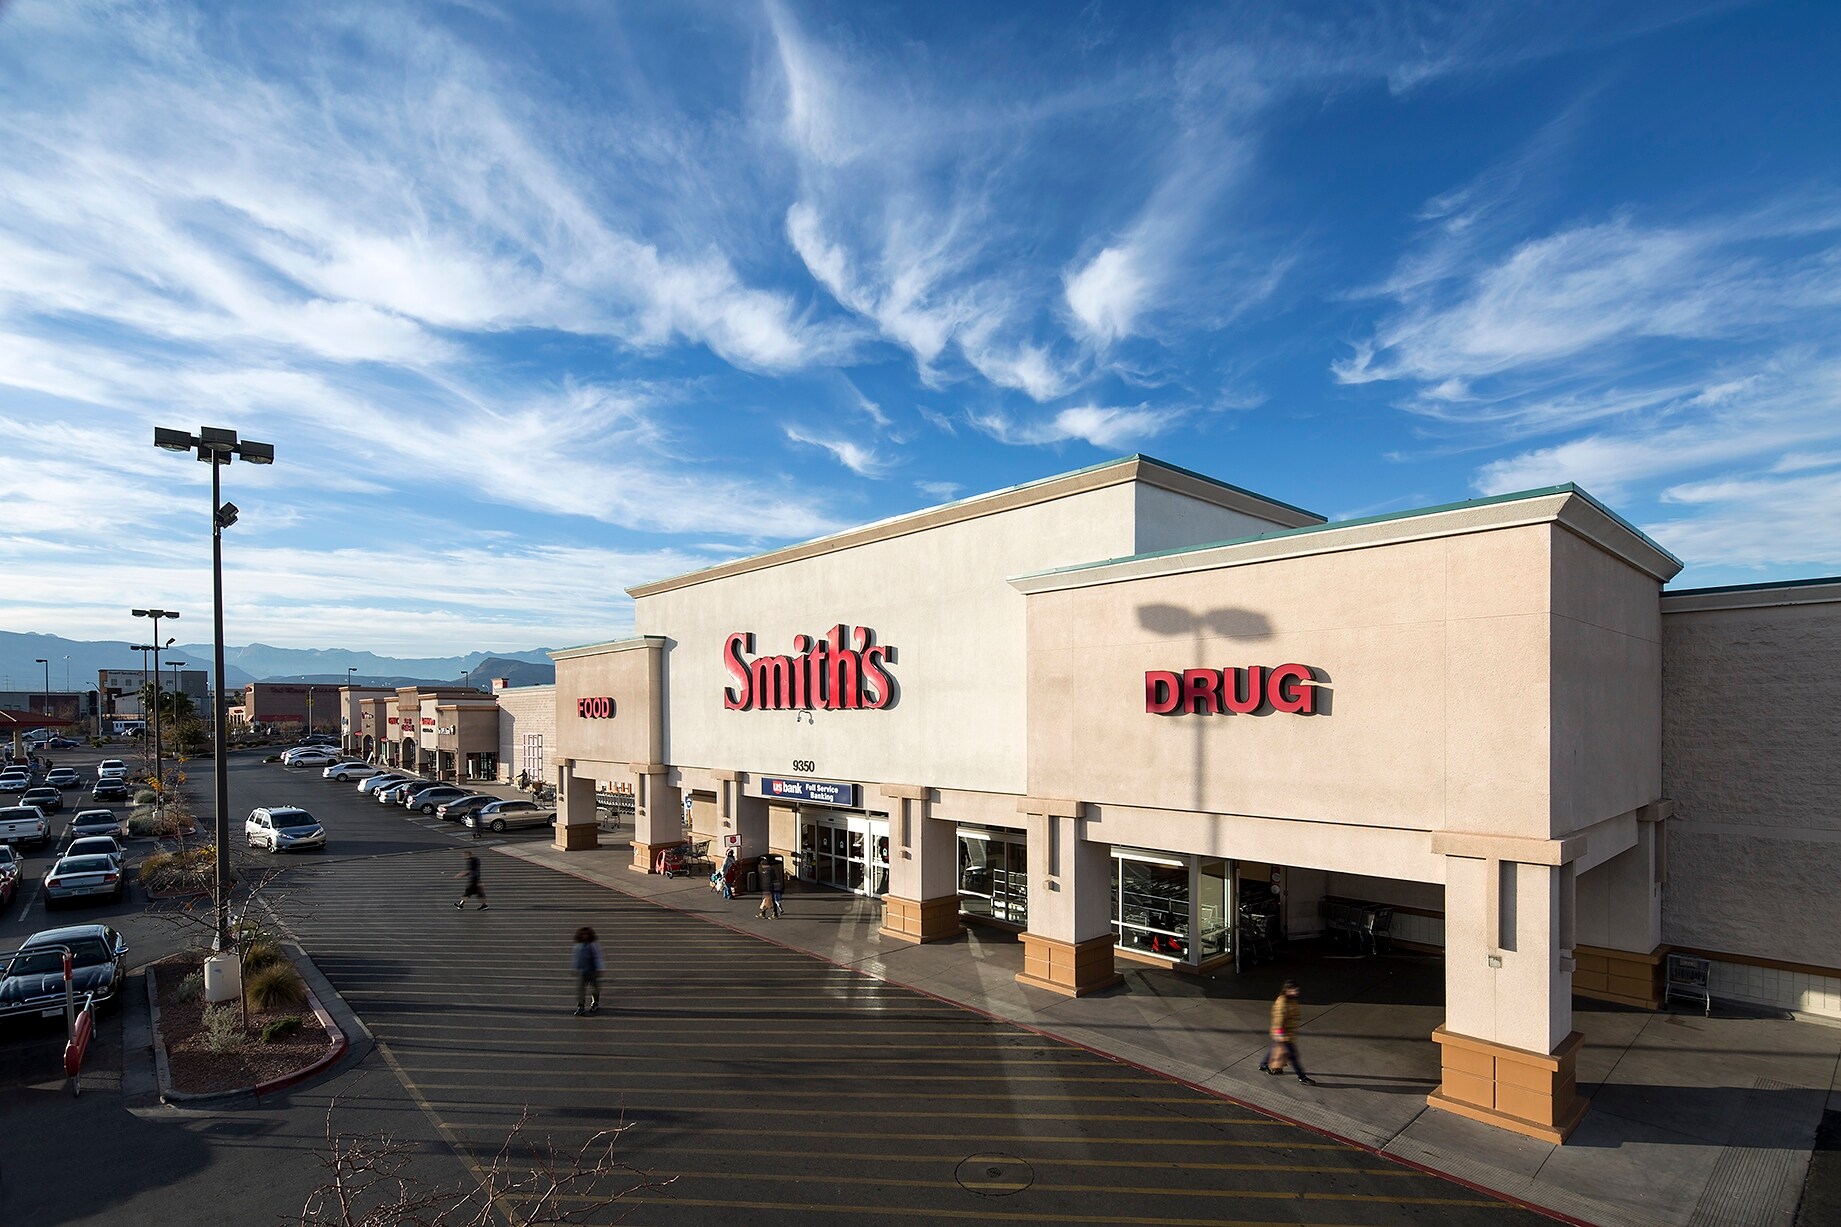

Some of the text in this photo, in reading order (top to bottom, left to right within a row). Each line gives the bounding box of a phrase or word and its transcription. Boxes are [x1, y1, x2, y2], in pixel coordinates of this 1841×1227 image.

[723, 624, 893, 711] Smith's
[1145, 663, 1315, 714] DRUG
[577, 696, 611, 718] FOOD
[793, 760, 815, 772] 9350
[806, 784, 816, 792] Full
[817, 785, 838, 794] Service
[810, 792, 833, 802] Banking
